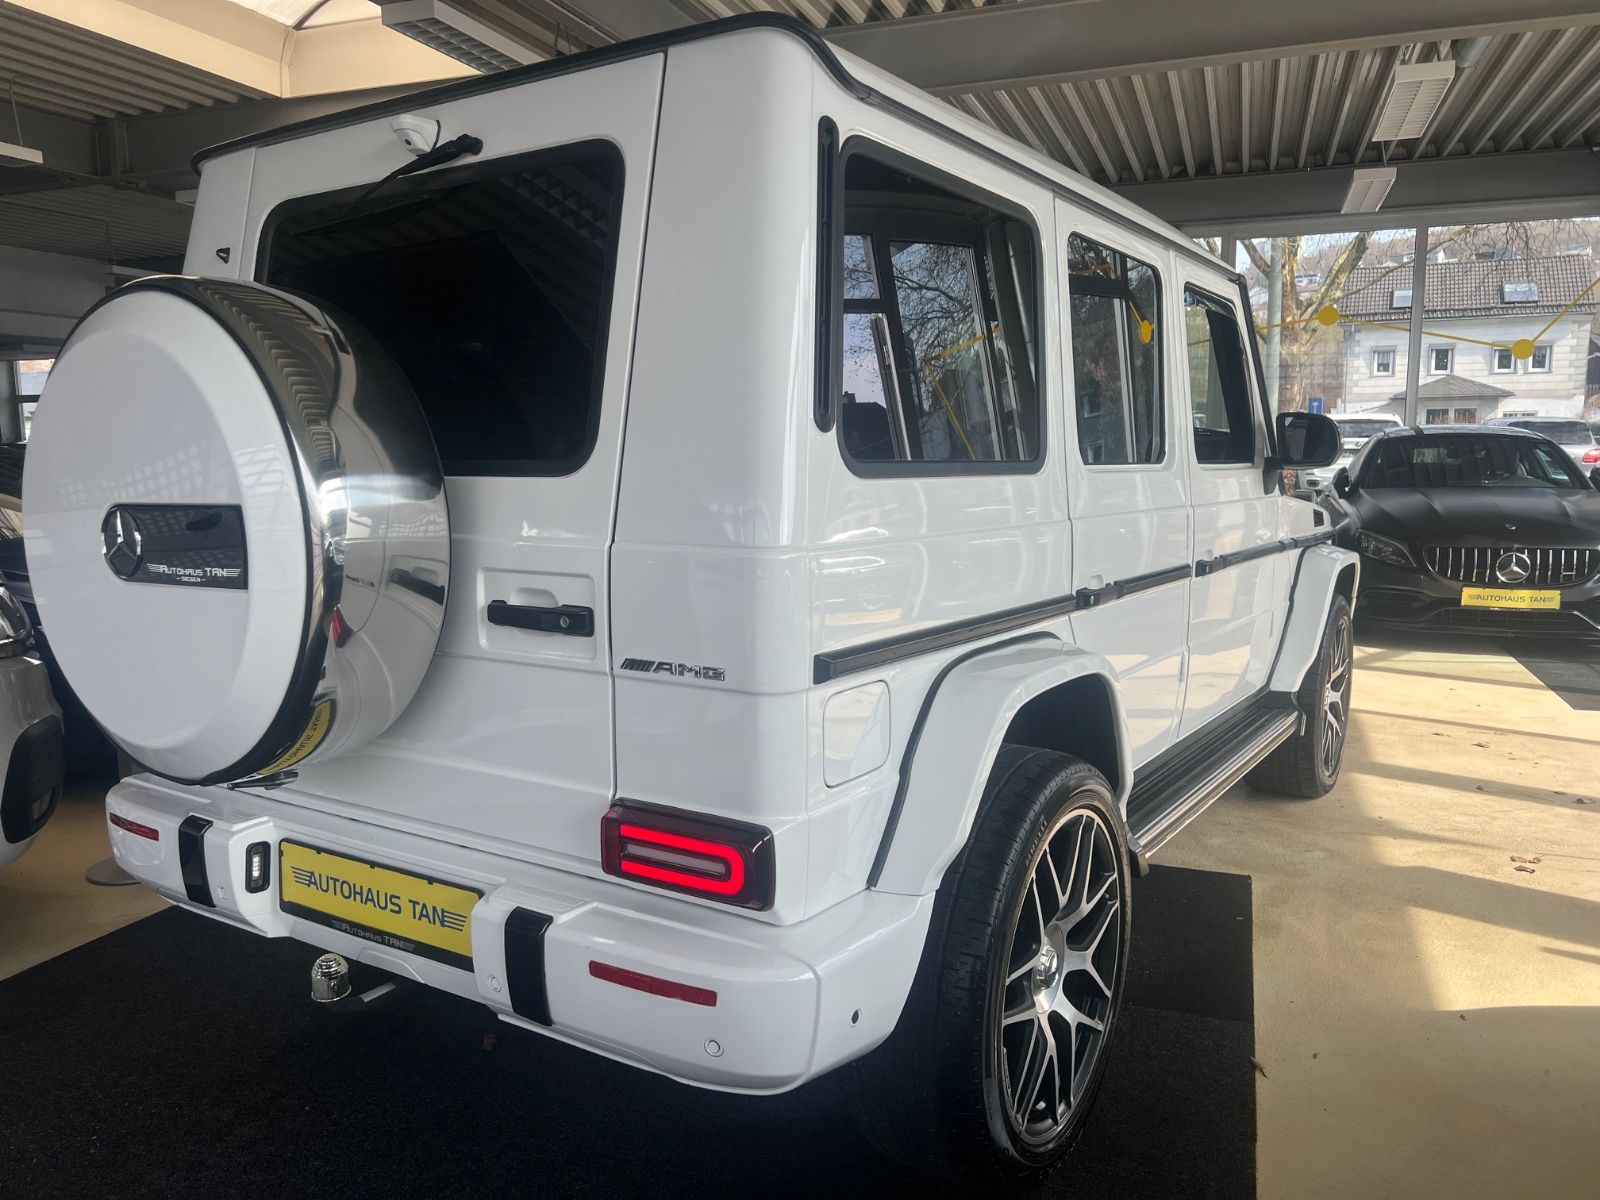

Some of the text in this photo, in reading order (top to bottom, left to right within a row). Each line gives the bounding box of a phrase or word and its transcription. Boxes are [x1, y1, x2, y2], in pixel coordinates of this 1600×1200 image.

[160, 564, 226, 577] AUTOHAUS TAN
[1476, 593, 1526, 603] AUTOHAUS
[652, 661, 725, 681] AMG
[308, 871, 446, 928] AUTOHAUS TAN
[342, 923, 403, 948] AUTOHAUS TAN
